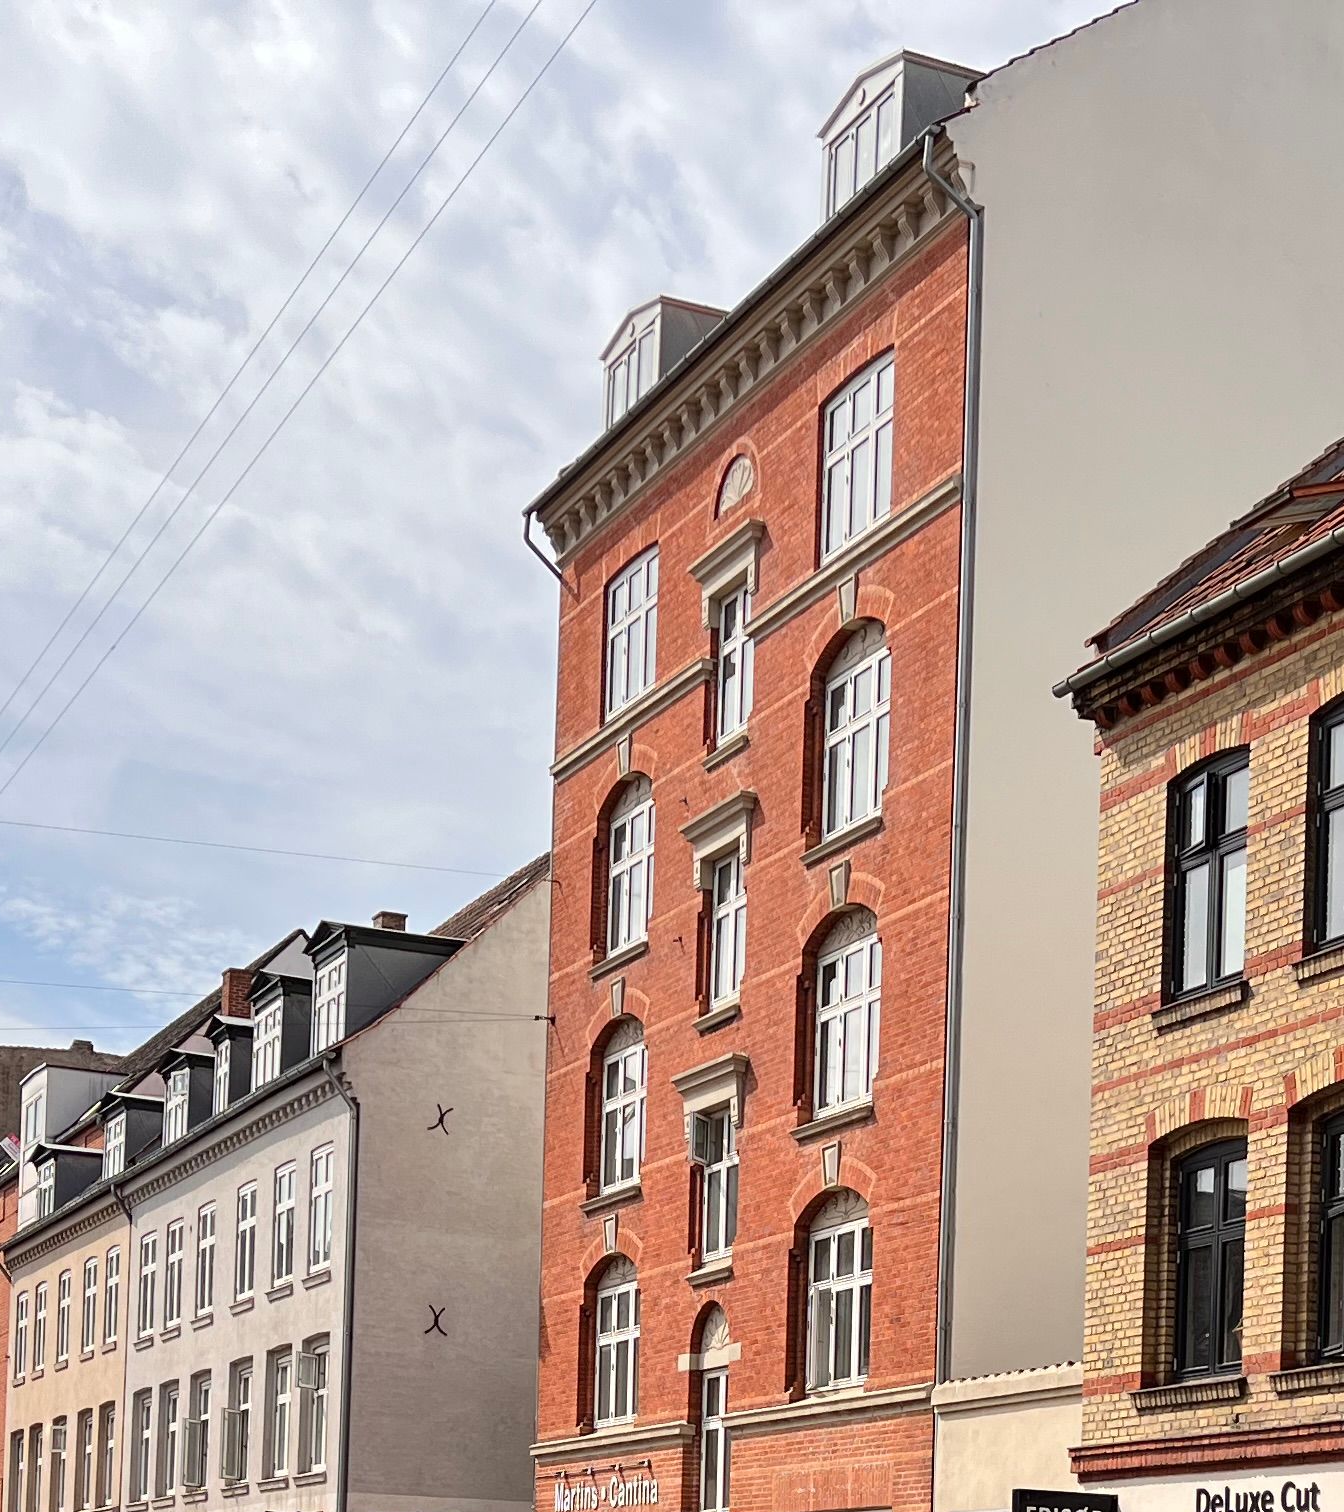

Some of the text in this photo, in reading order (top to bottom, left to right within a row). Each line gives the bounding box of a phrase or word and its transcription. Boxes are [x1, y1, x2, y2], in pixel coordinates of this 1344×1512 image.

[554, 1473, 659, 1512] Martins Cantina
[1280, 1480, 1321, 1512] Cut
